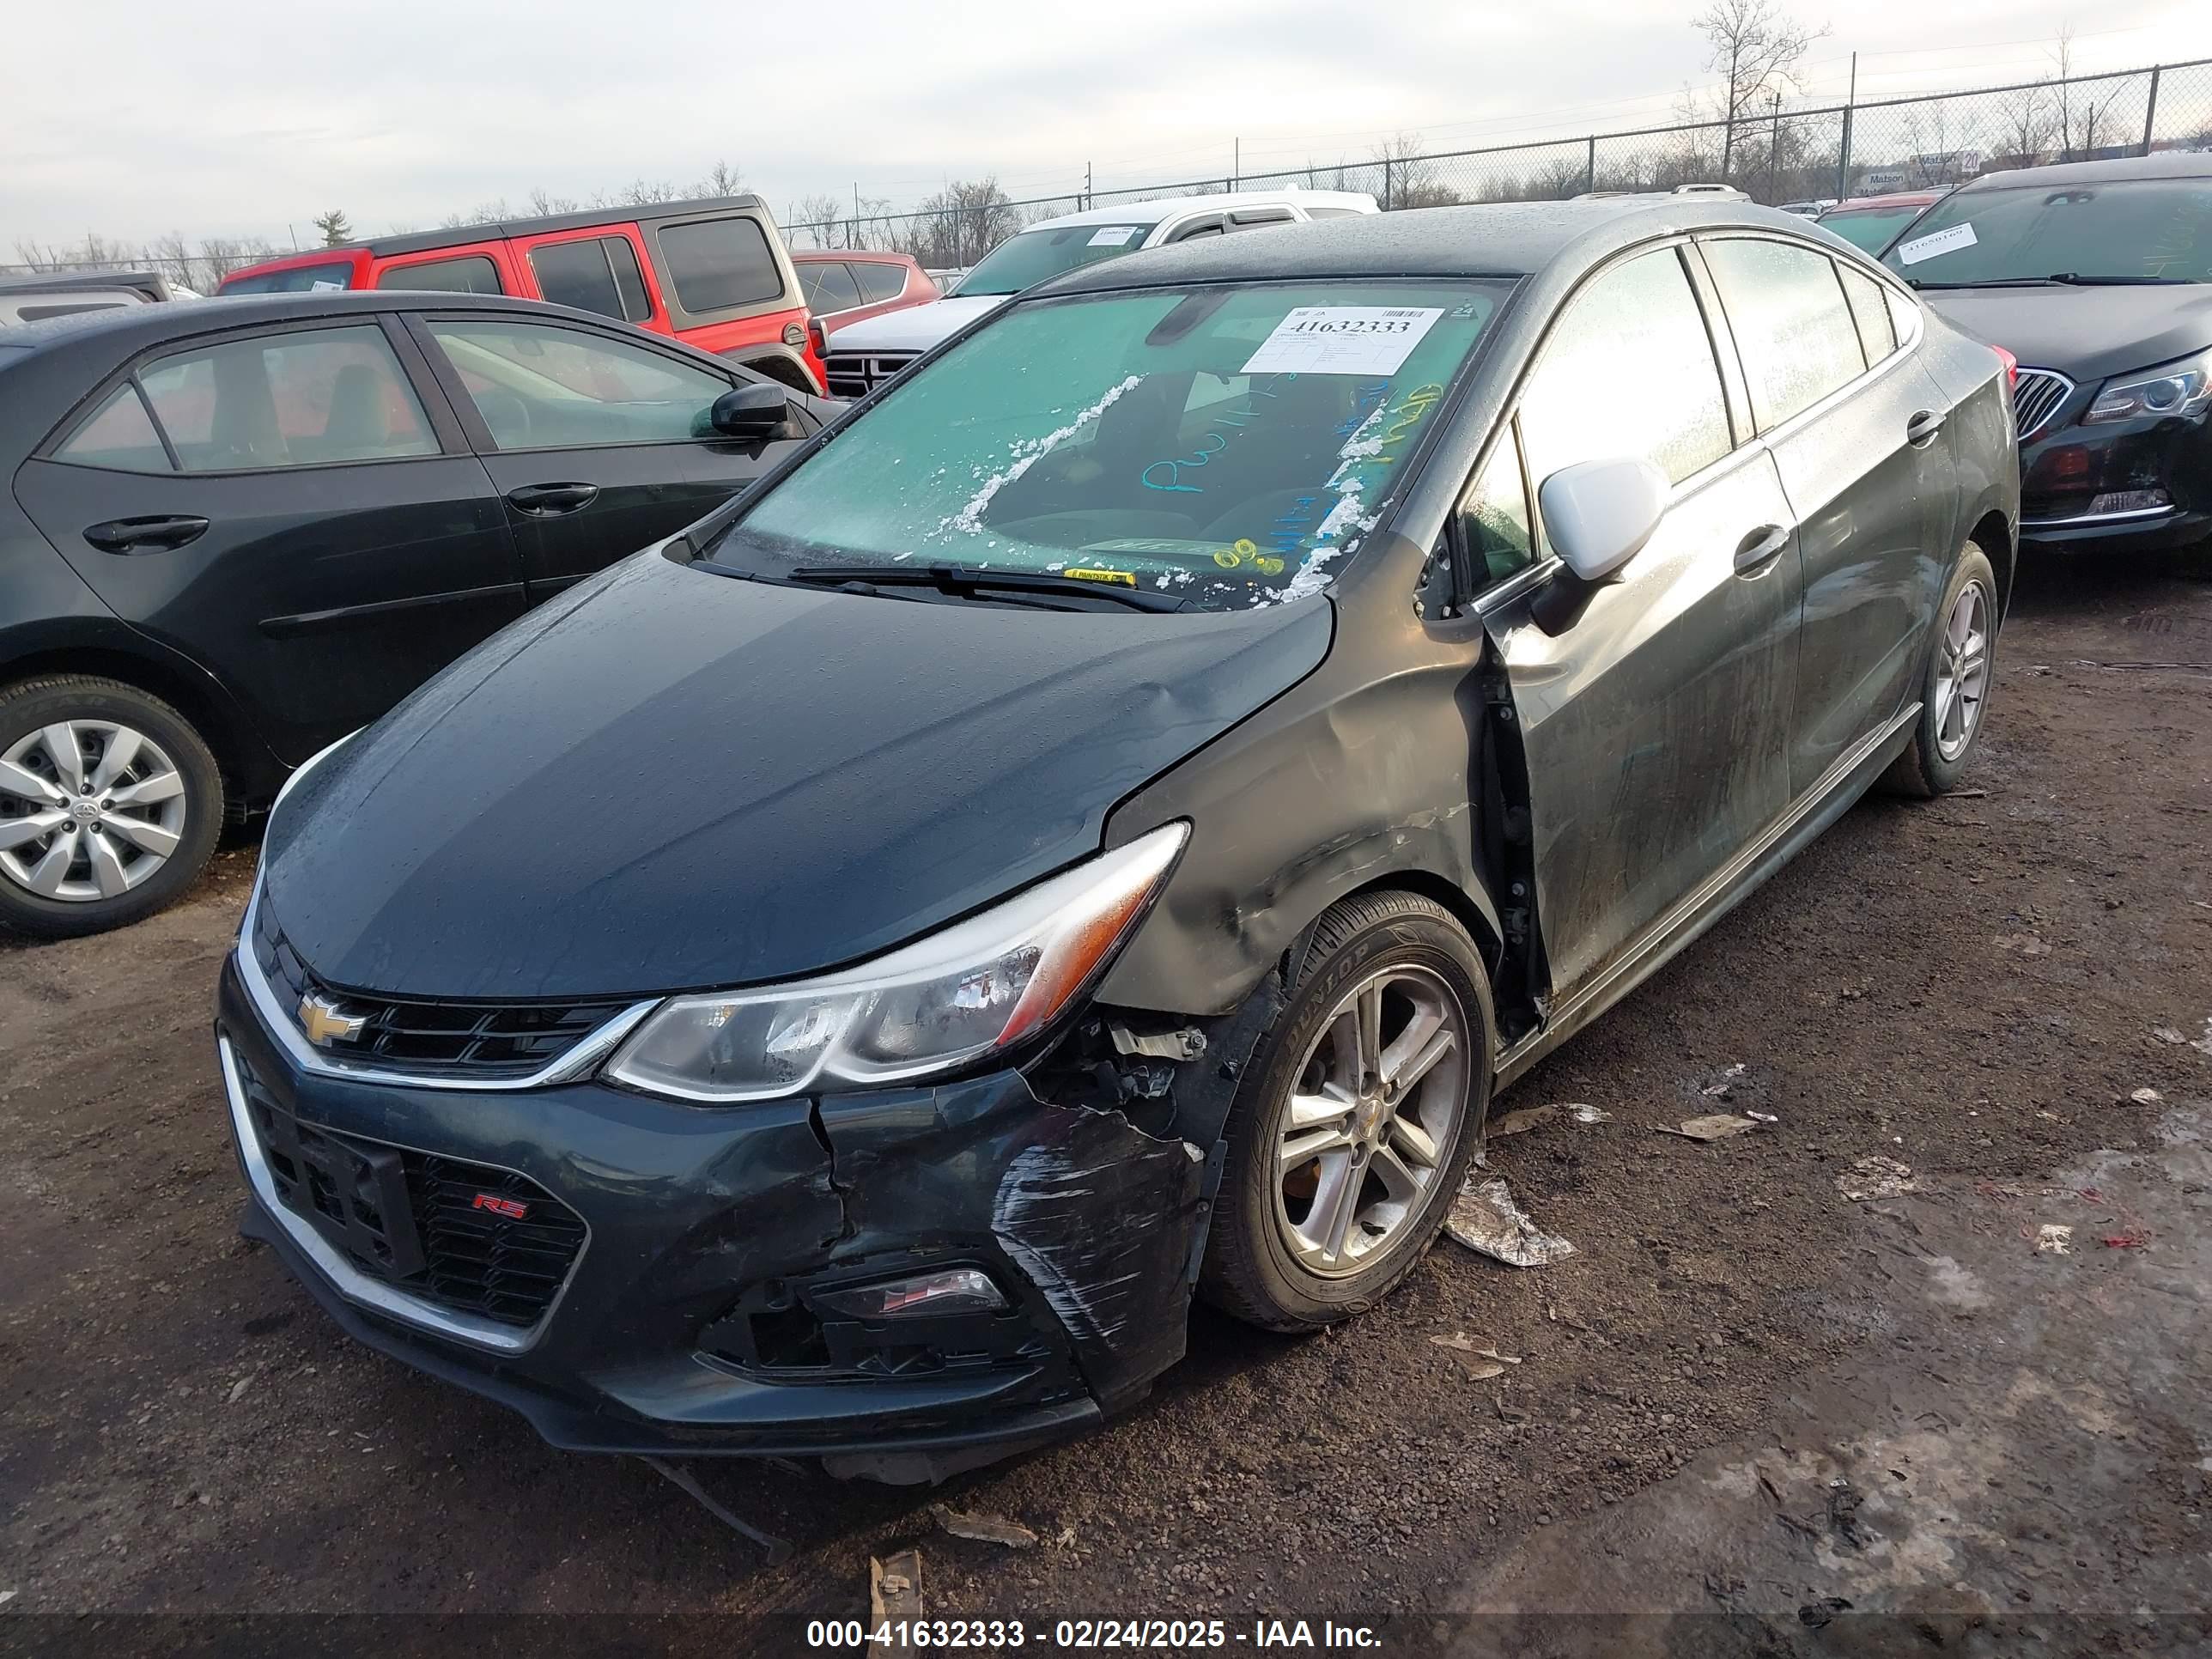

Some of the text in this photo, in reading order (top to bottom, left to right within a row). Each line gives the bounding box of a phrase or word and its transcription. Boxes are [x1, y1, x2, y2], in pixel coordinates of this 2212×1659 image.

[1965, 154, 1978, 168] 20
[1869, 174, 1904, 185] Matson
[1290, 319, 1412, 334] 41632333
[471, 1194, 530, 1219] RS
